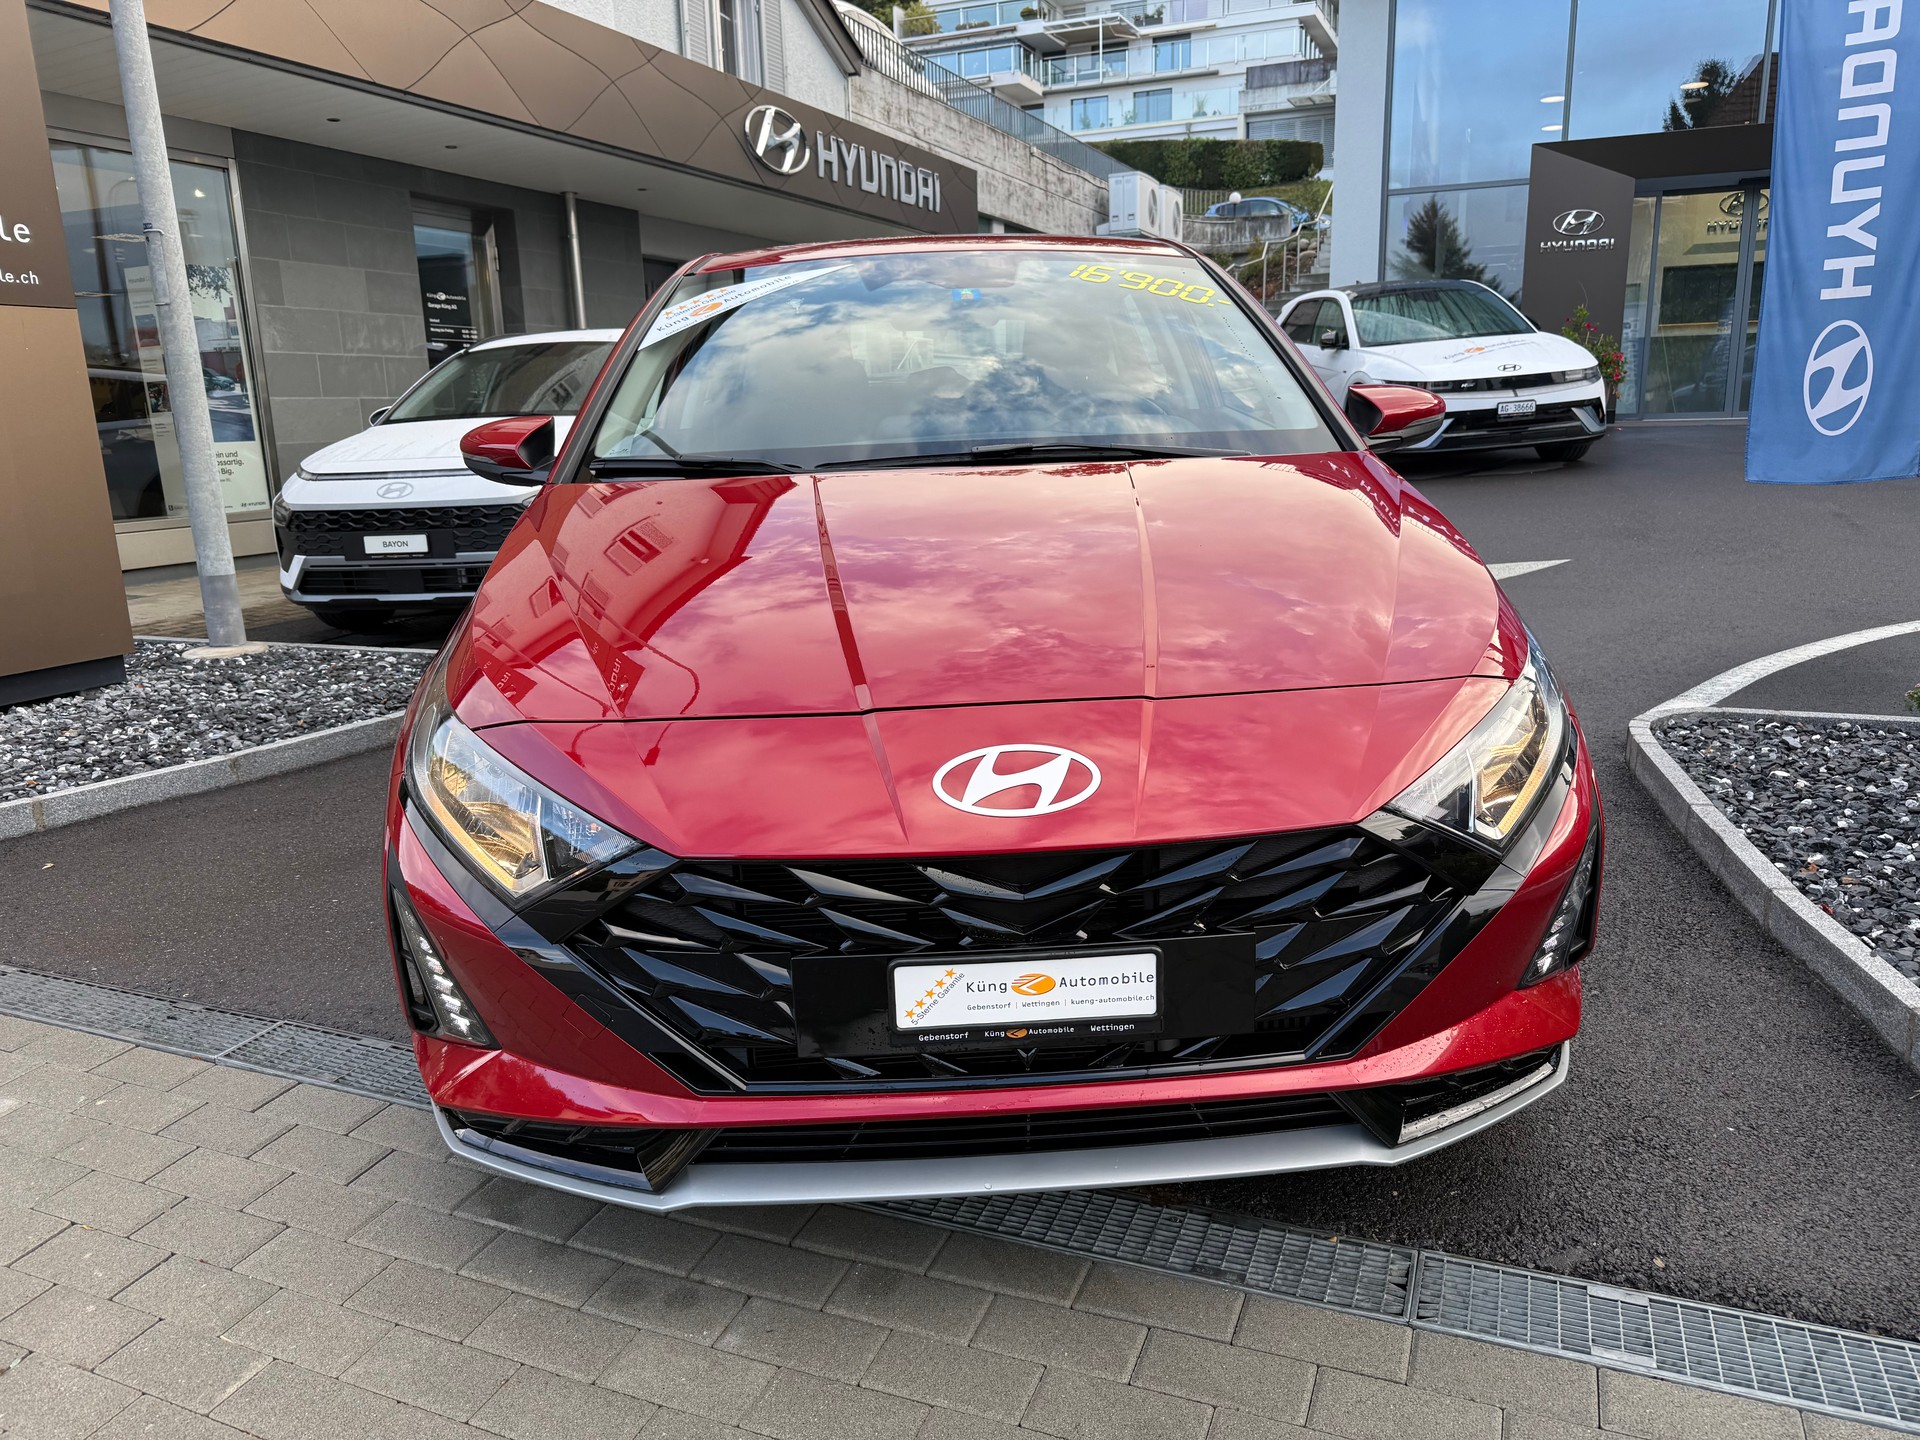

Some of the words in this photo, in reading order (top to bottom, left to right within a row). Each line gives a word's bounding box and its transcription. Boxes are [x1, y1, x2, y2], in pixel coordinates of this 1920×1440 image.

[816, 130, 941, 213] HYUNDAI
[1539, 238, 1615, 252] HYUNDAI
[656, 315, 691, 332] Küng
[723, 275, 792, 303] Automobile
[382, 540, 409, 548] BAYON
[966, 980, 1008, 994] Küng
[1059, 971, 1155, 988] Automobile
[911, 999, 939, 1026] 5-Sterne
[937, 972, 966, 999] Garantie
[967, 1002, 1012, 1011] Gebenstorf
[1021, 1000, 1060, 1008] Wettingen
[1070, 994, 1155, 1006] kueng-automobile.ch
[918, 1031, 969, 1042] Gebenstorf
[984, 1030, 1006, 1038] Küng
[1028, 1026, 1075, 1035] Automobile
[1090, 1023, 1135, 1033] Wettingen
